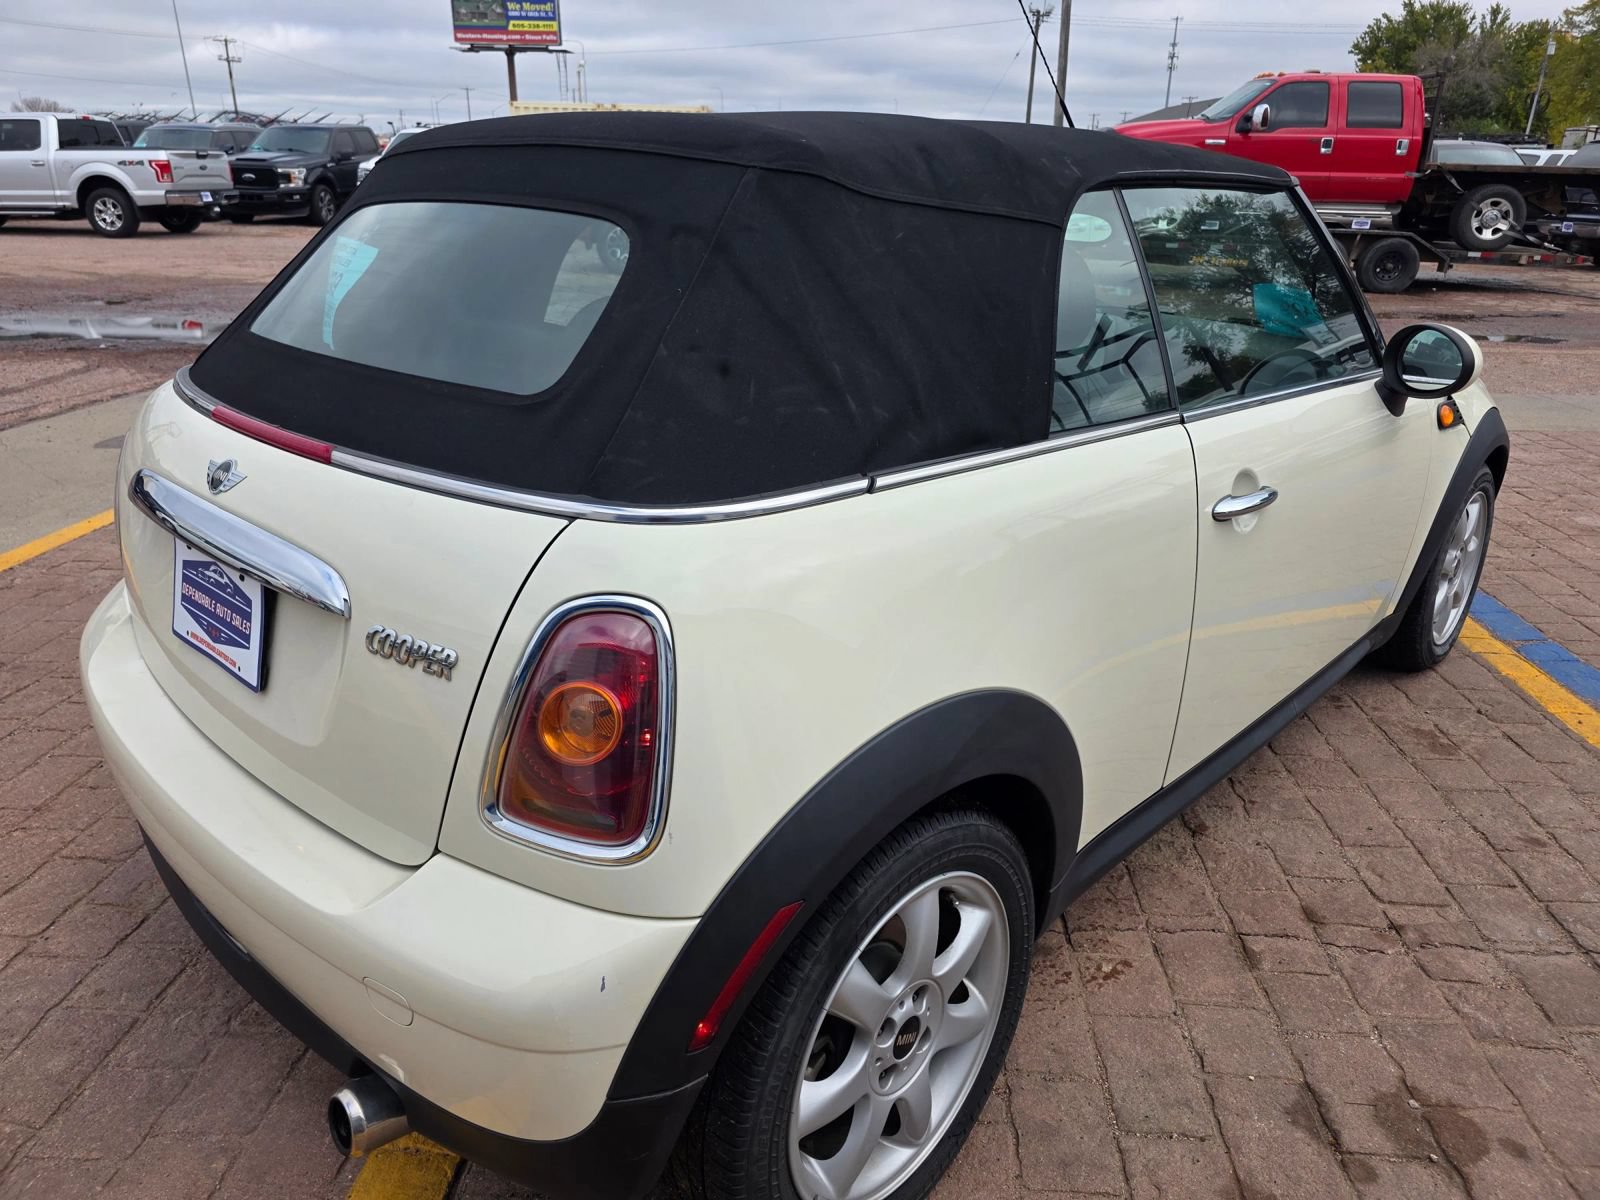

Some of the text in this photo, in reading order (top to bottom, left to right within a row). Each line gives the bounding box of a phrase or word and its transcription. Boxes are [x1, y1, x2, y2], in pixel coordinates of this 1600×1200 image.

[507, 2, 554, 11] We Moved!
[182, 582, 251, 634] DEPENDABLE AUTO SALES
[365, 624, 458, 682] COOPER
[896, 1031, 917, 1046] MINI
